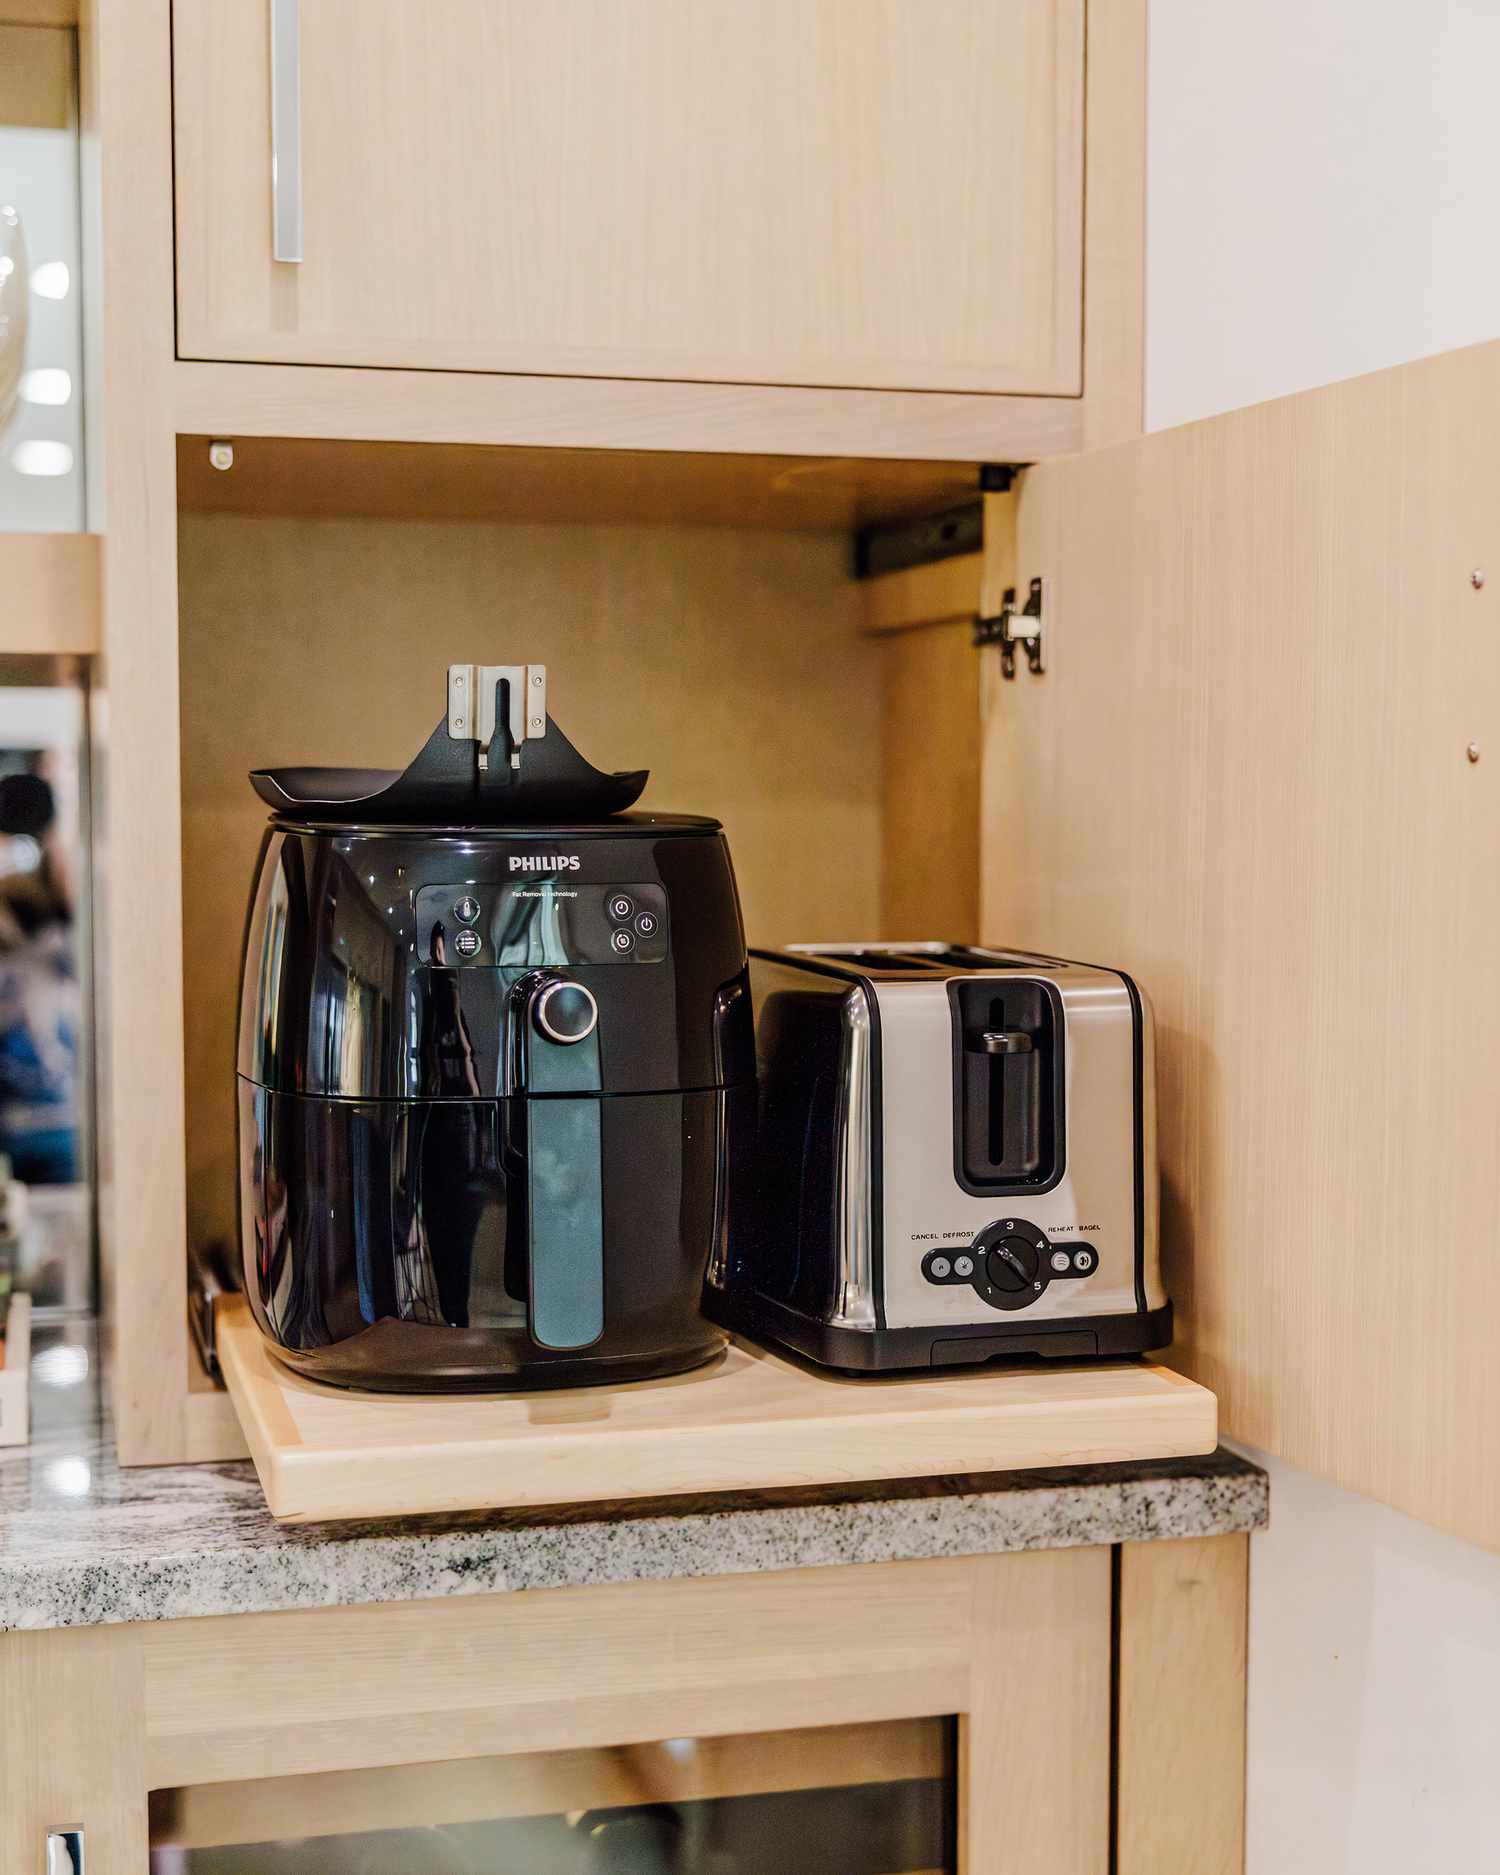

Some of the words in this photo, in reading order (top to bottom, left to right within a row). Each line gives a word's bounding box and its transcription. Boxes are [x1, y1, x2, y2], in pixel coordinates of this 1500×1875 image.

[509, 856, 580, 870] PHILIPS
[1006, 1221, 1014, 1230] 3
[911, 1232, 939, 1240] CANCEL
[942, 1231, 975, 1239] DEFROST
[1036, 1240, 1045, 1249] 4
[978, 1246, 986, 1255] 2
[987, 1286, 993, 1294] 1
[1034, 1281, 1042, 1291] 5
